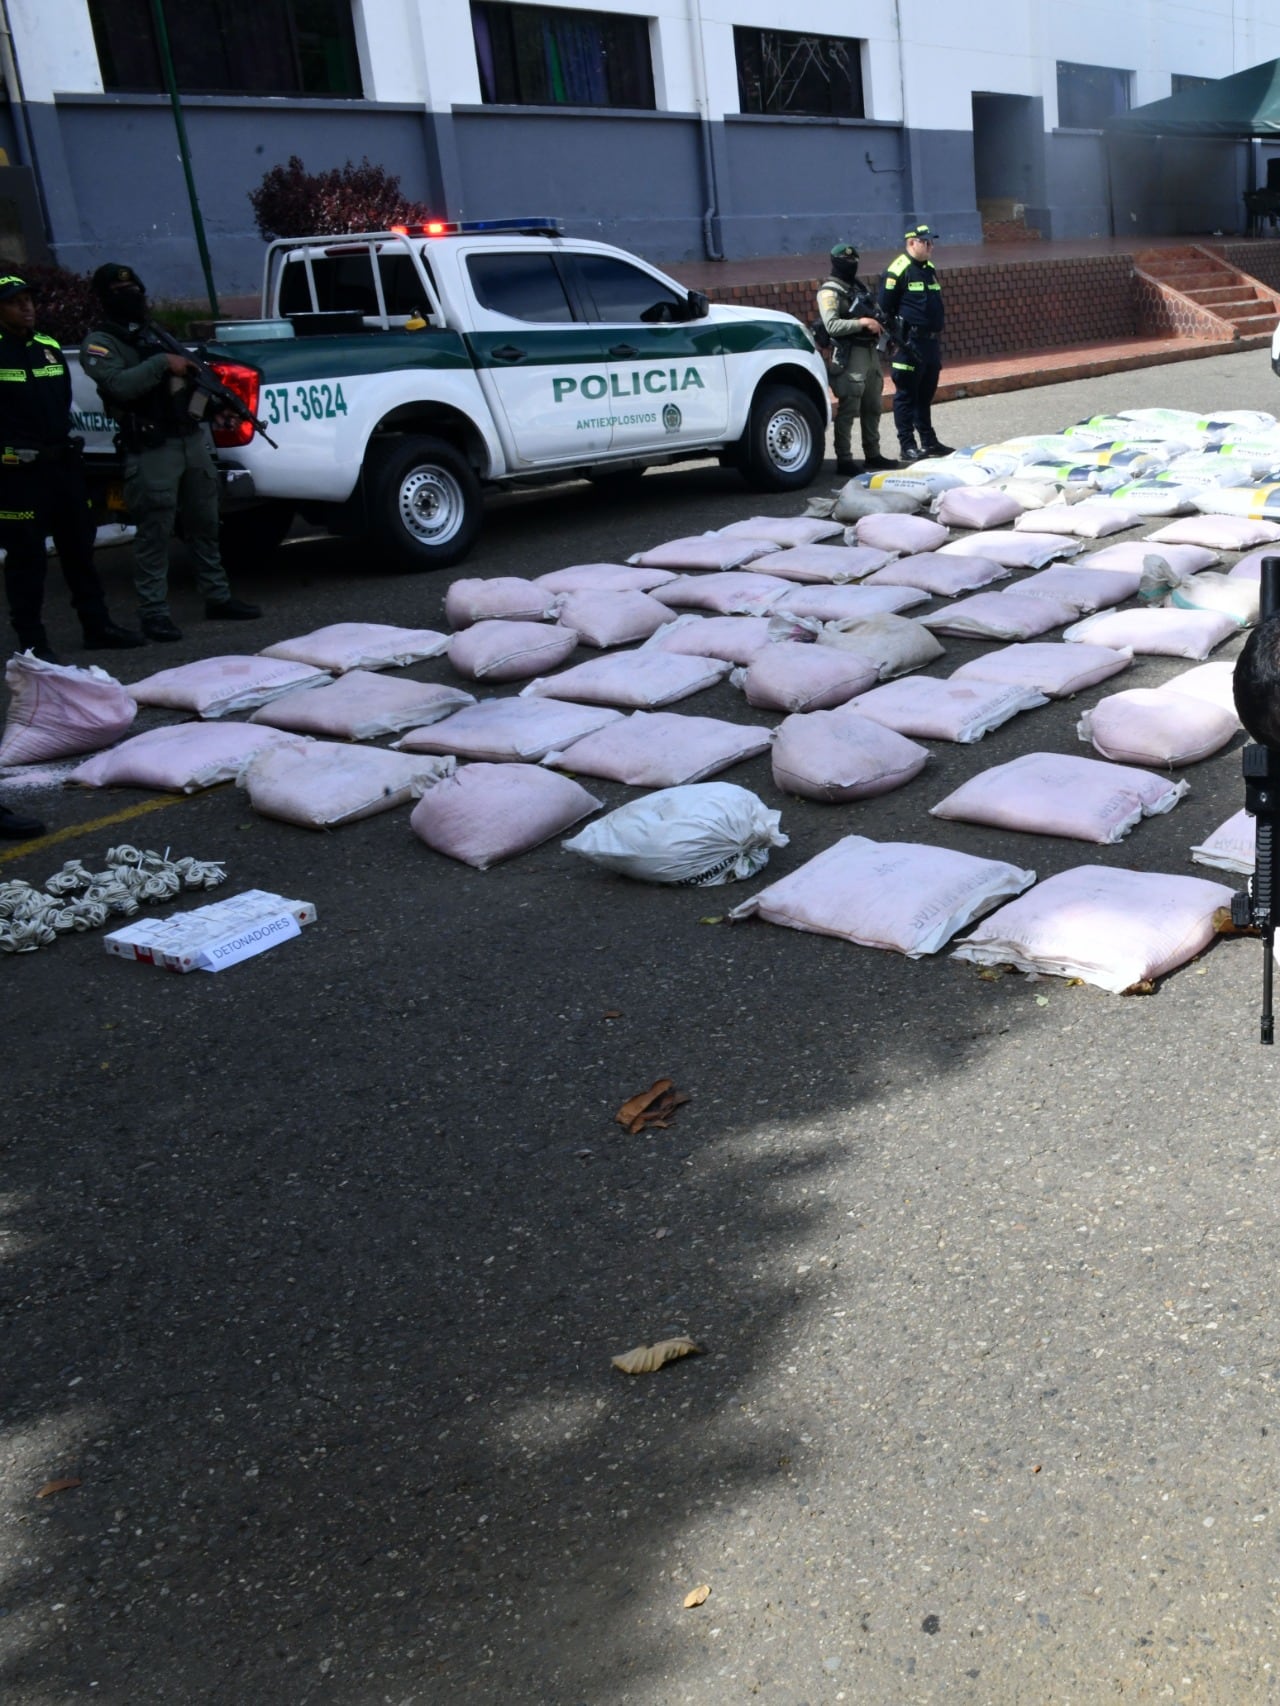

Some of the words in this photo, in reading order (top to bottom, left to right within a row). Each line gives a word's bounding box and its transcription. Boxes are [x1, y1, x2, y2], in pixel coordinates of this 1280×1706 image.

[264, 382, 348, 424] 37-3624
[552, 366, 705, 403] POLICIA
[576, 413, 657, 430] ANTIEXPLOSIVOS
[212, 917, 290, 959] DETONADORES
